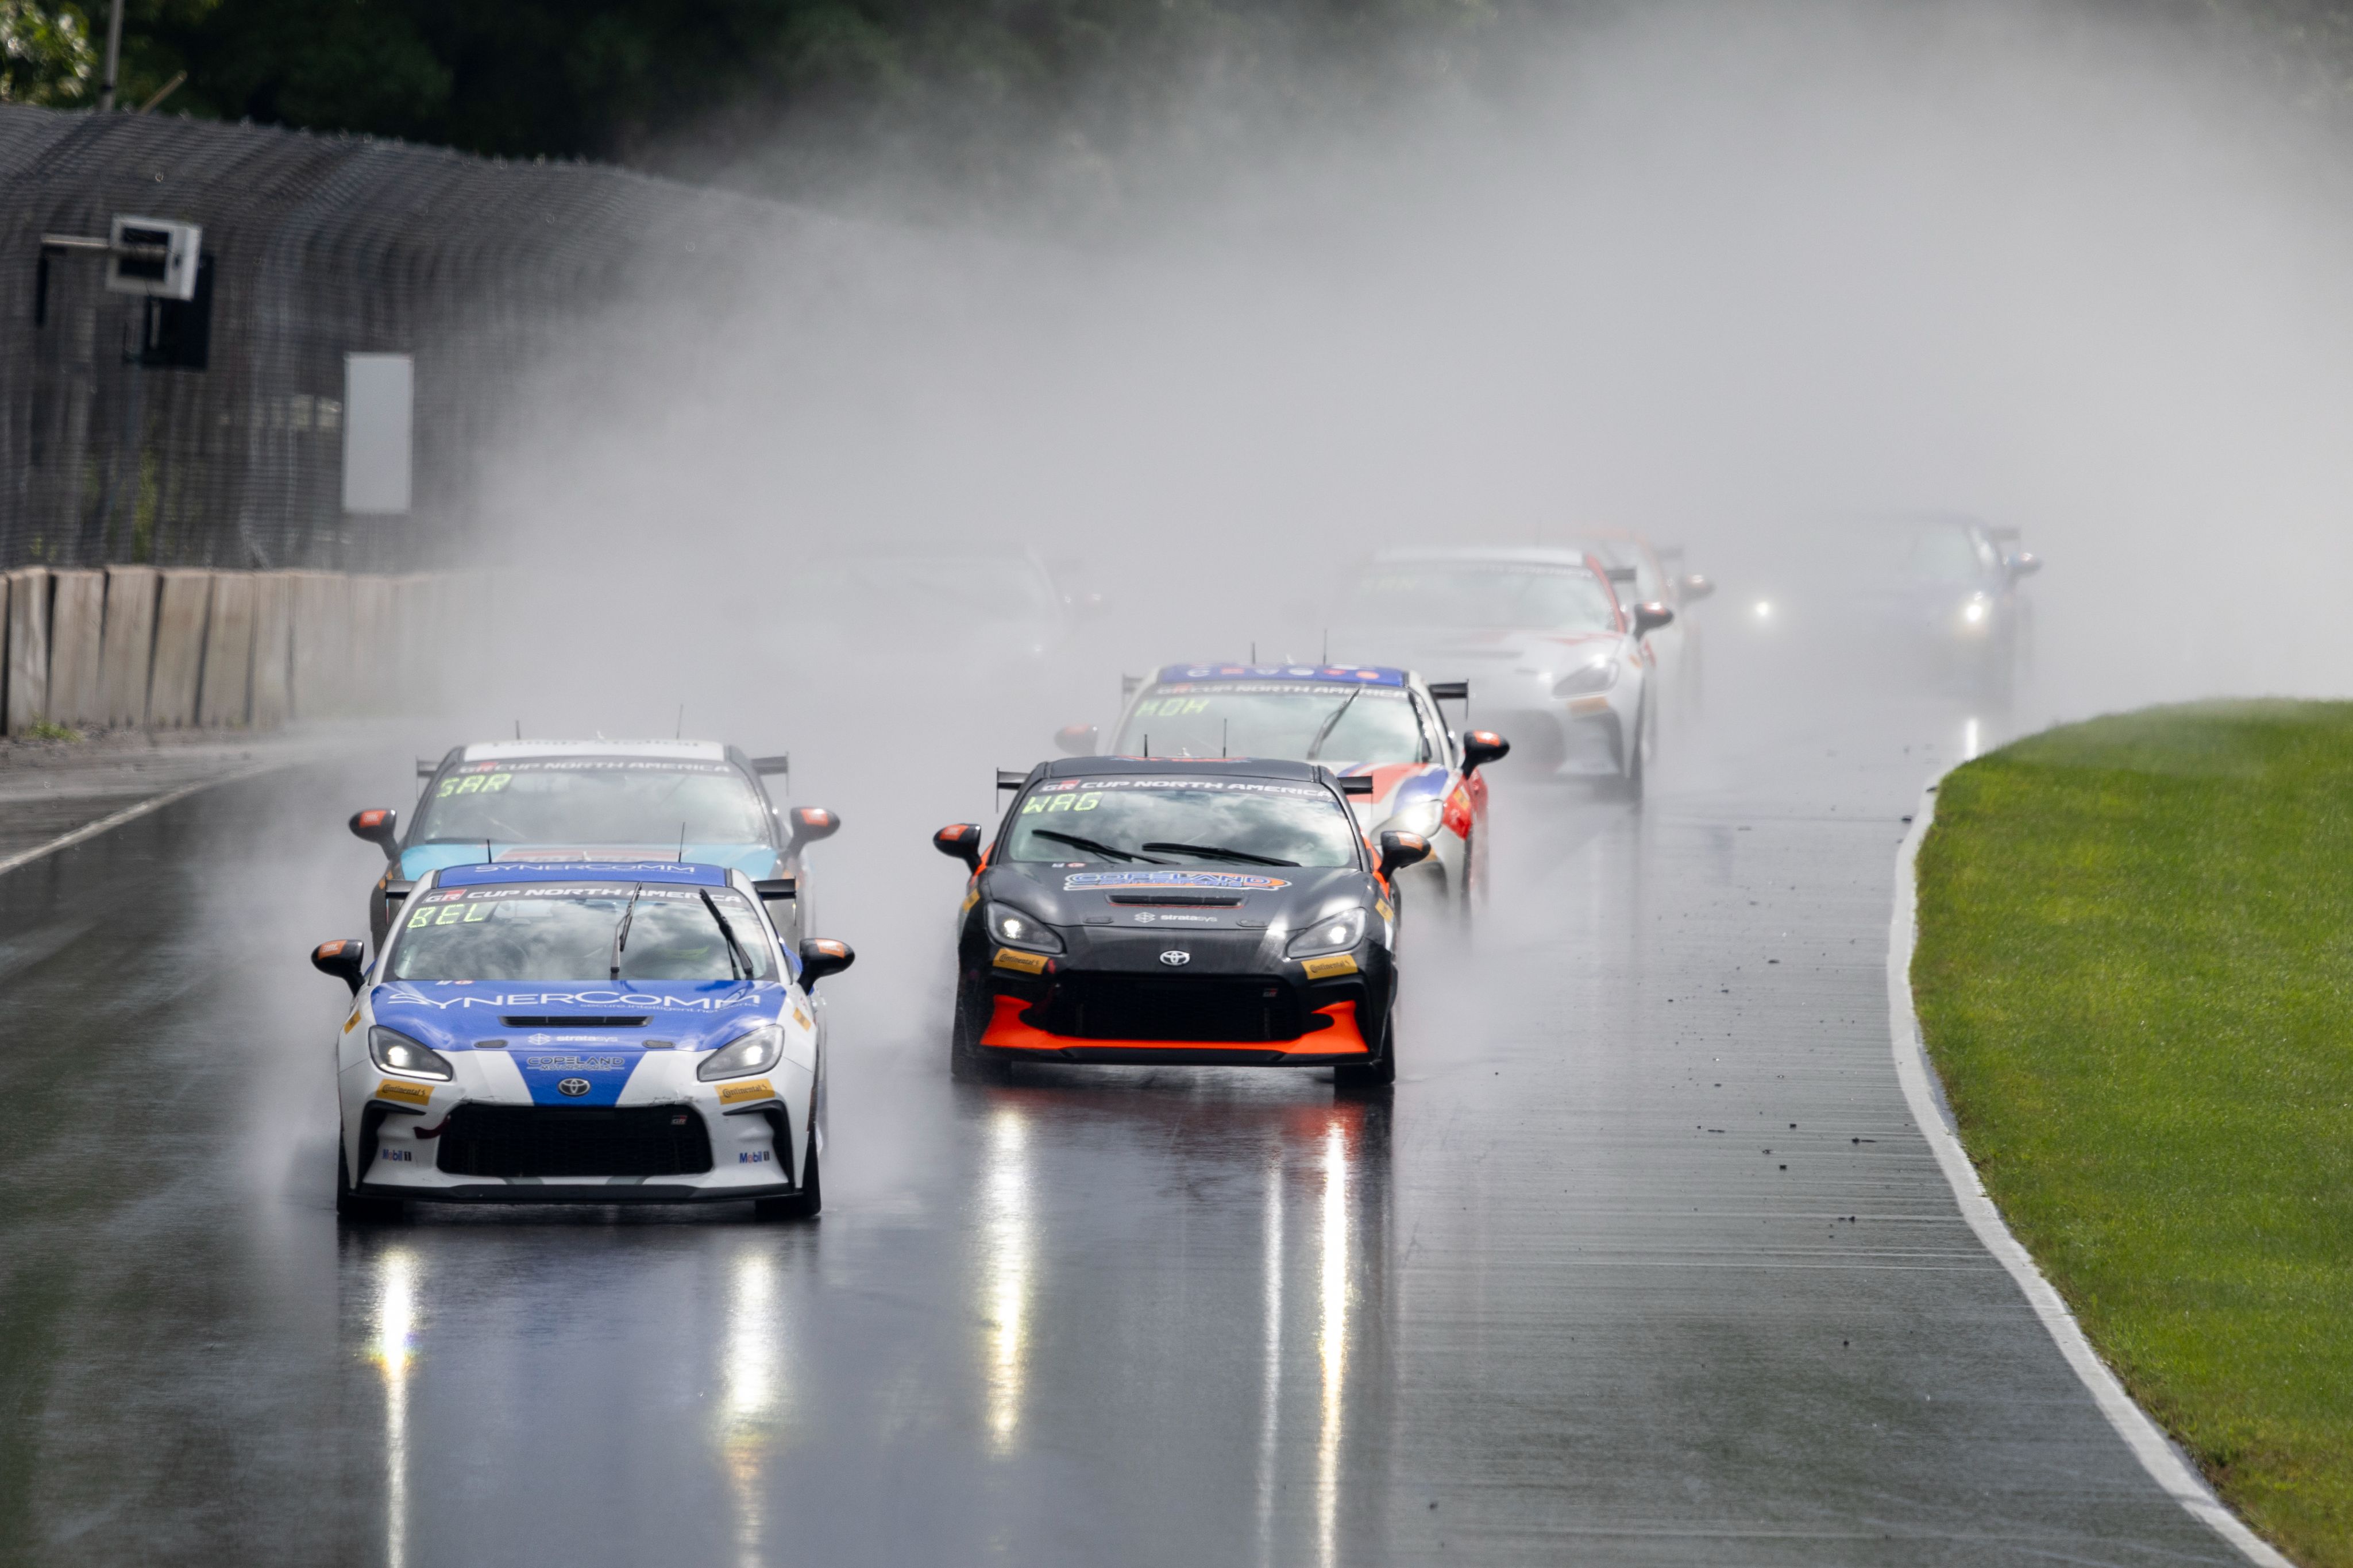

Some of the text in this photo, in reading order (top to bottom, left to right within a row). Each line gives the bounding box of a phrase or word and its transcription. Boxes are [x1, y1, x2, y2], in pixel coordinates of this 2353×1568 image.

[1236, 684, 1310, 693] NORTH
[1313, 686, 1408, 698] AMERICA
[628, 762, 730, 773] AMERICA
[436, 773, 512, 798] SAR
[1081, 781, 1130, 789] CUP
[1134, 781, 1223, 789] NORTH
[1228, 783, 1333, 798] AMERICA
[1021, 791, 1103, 814] WAG
[425, 894, 460, 902] GR
[467, 890, 520, 899] CUP
[627, 890, 742, 903] AMERCA
[407, 903, 484, 928] BEL
[1160, 914, 1218, 922] stratasys
[527, 1056, 624, 1065] COPELAND
[723, 1084, 762, 1098] Continental
